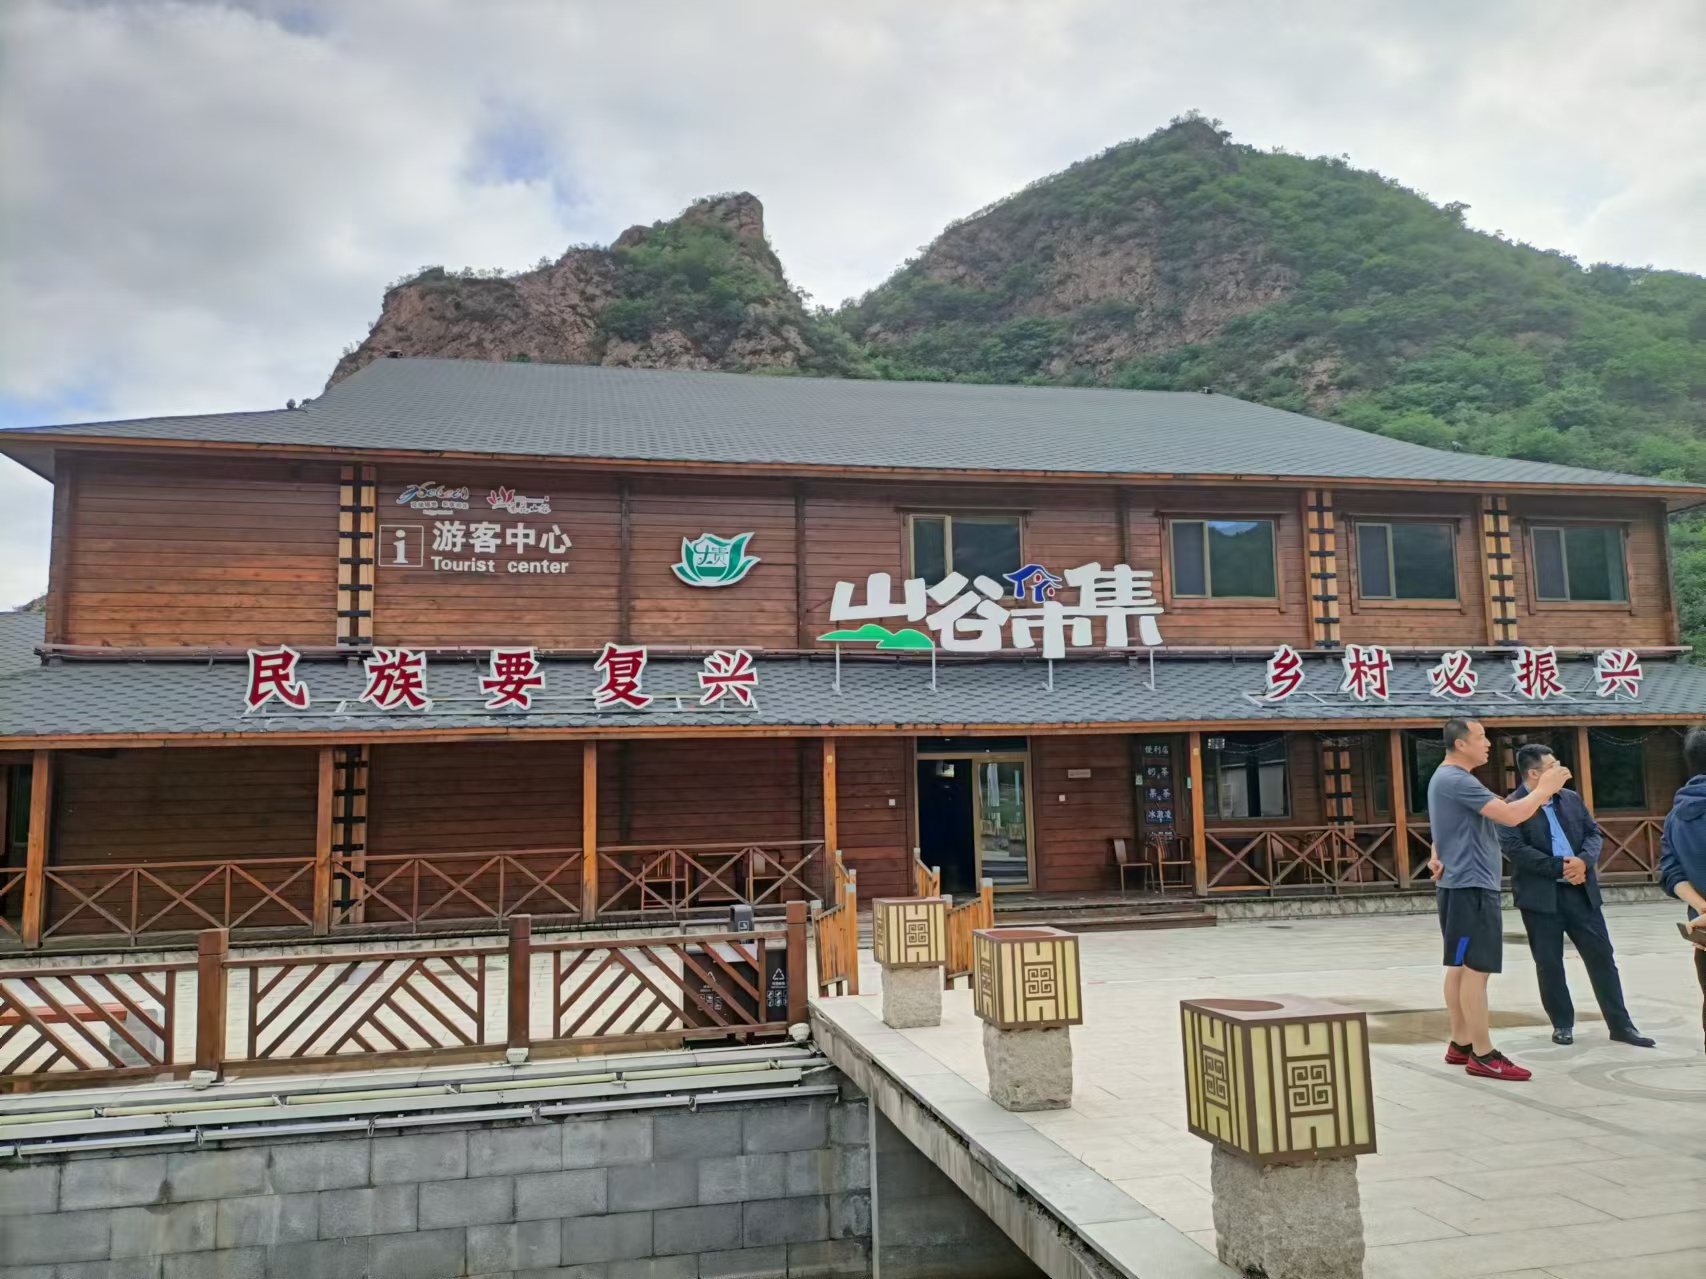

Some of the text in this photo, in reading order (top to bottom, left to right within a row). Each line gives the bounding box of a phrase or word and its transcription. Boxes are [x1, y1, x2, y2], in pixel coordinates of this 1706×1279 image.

[431, 556, 569, 574] Tourist center
[432, 520, 572, 554] 游客中心
[829, 561, 1164, 659] 山谷市集
[247, 643, 758, 709] 民族要复兴
[1266, 644, 1642, 700] 乡村必振兴
